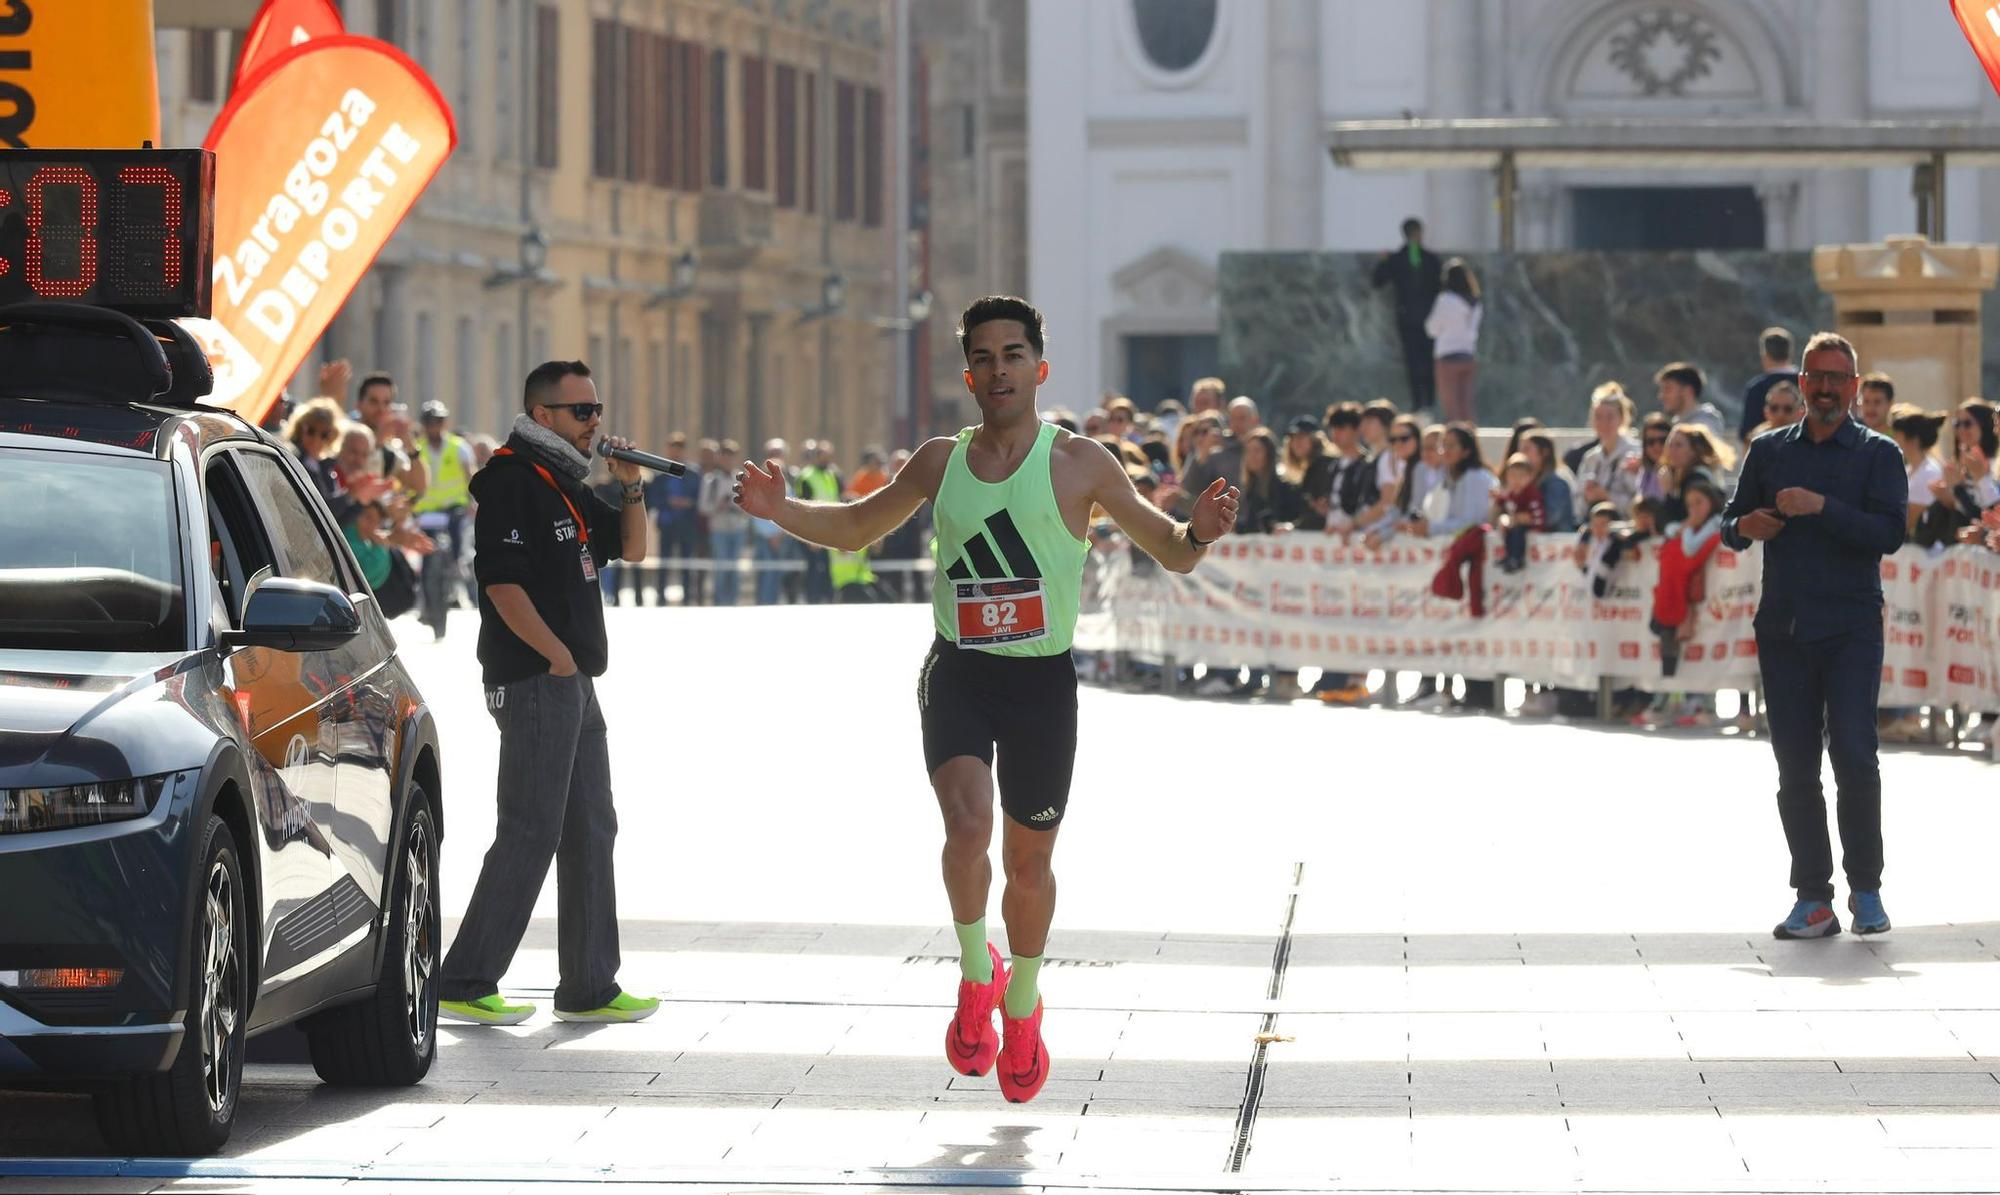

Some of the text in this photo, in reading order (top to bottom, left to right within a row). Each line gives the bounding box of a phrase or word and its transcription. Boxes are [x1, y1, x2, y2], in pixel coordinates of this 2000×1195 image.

[212, 88, 377, 307] Zaragoza
[245, 122, 422, 346] DEPORTE
[981, 601, 1018, 627] 82
[991, 625, 1011, 634] JAVI
